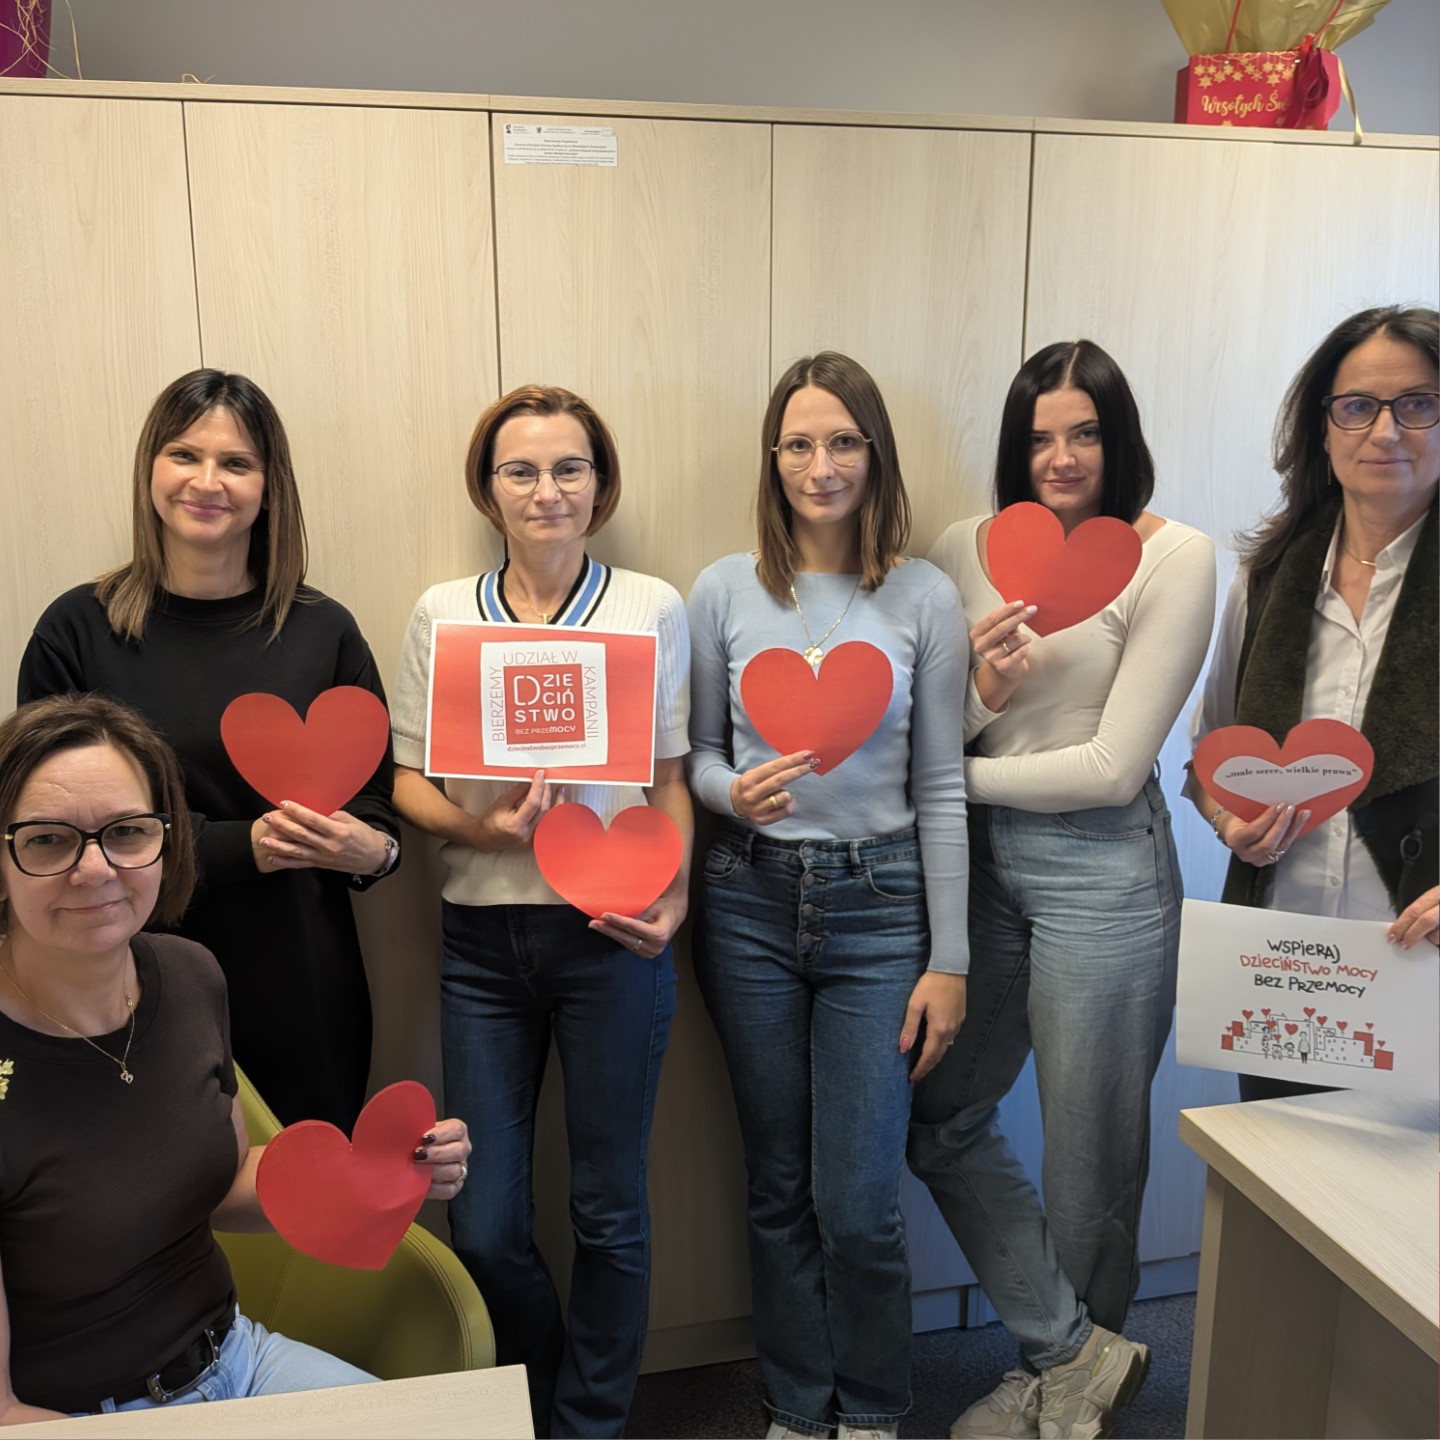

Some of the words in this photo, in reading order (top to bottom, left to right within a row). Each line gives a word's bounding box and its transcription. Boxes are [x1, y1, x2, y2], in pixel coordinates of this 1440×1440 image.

[503, 651, 559, 665] UDZIAŁ
[561, 650, 578, 663] W
[489, 666, 505, 742] BIERZEMY
[584, 666, 599, 738] KAMPANII
[514, 707, 576, 724] STWO
[1286, 766, 1320, 774] wielkie
